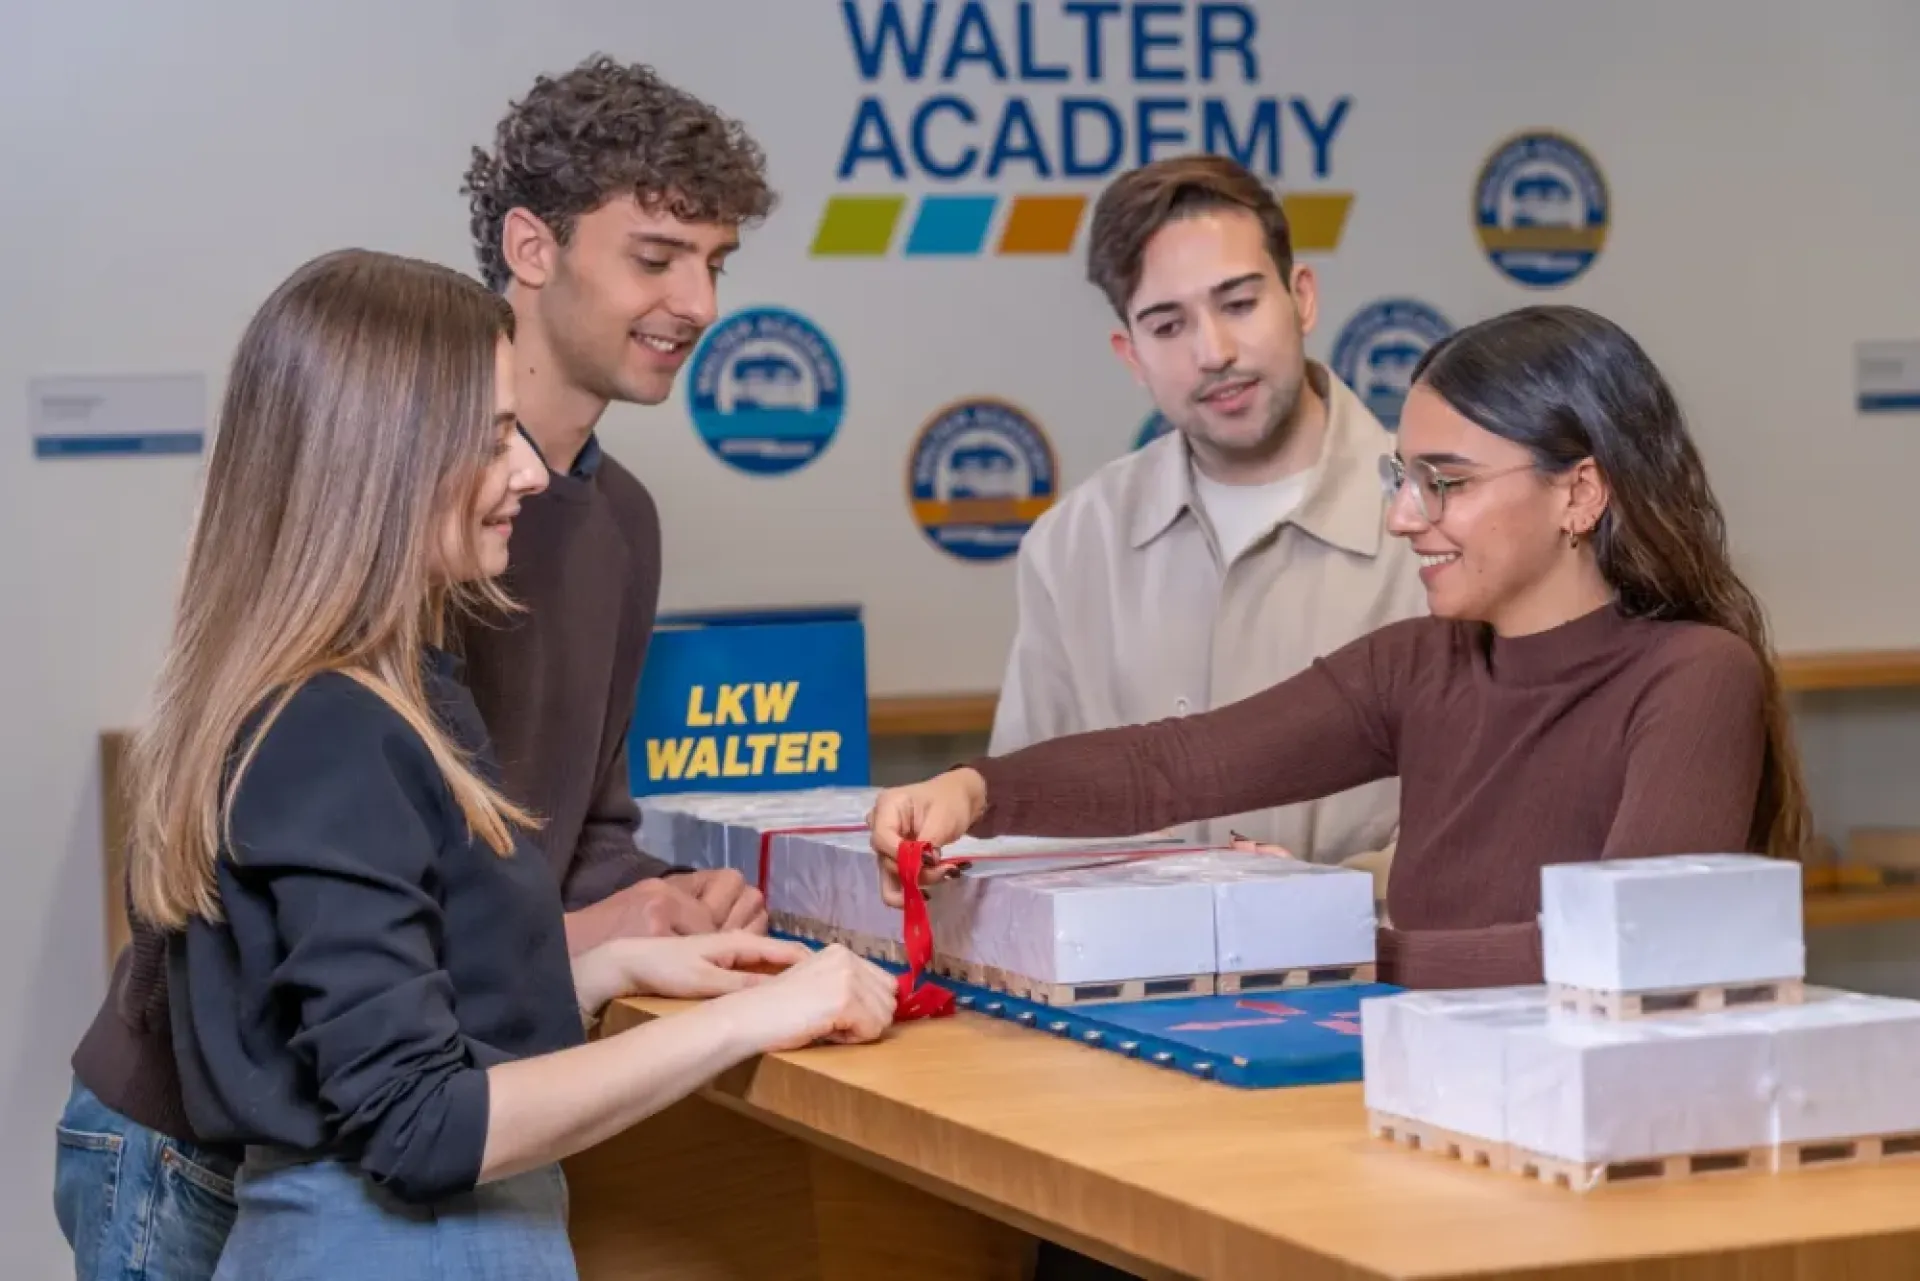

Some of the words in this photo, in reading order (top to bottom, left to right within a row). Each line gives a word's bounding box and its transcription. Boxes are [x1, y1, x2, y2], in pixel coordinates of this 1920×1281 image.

[841, 0, 1259, 81] WALTER
[837, 95, 1353, 179] ACADEMY
[687, 681, 799, 726] LKW
[646, 731, 841, 780] WALTER
